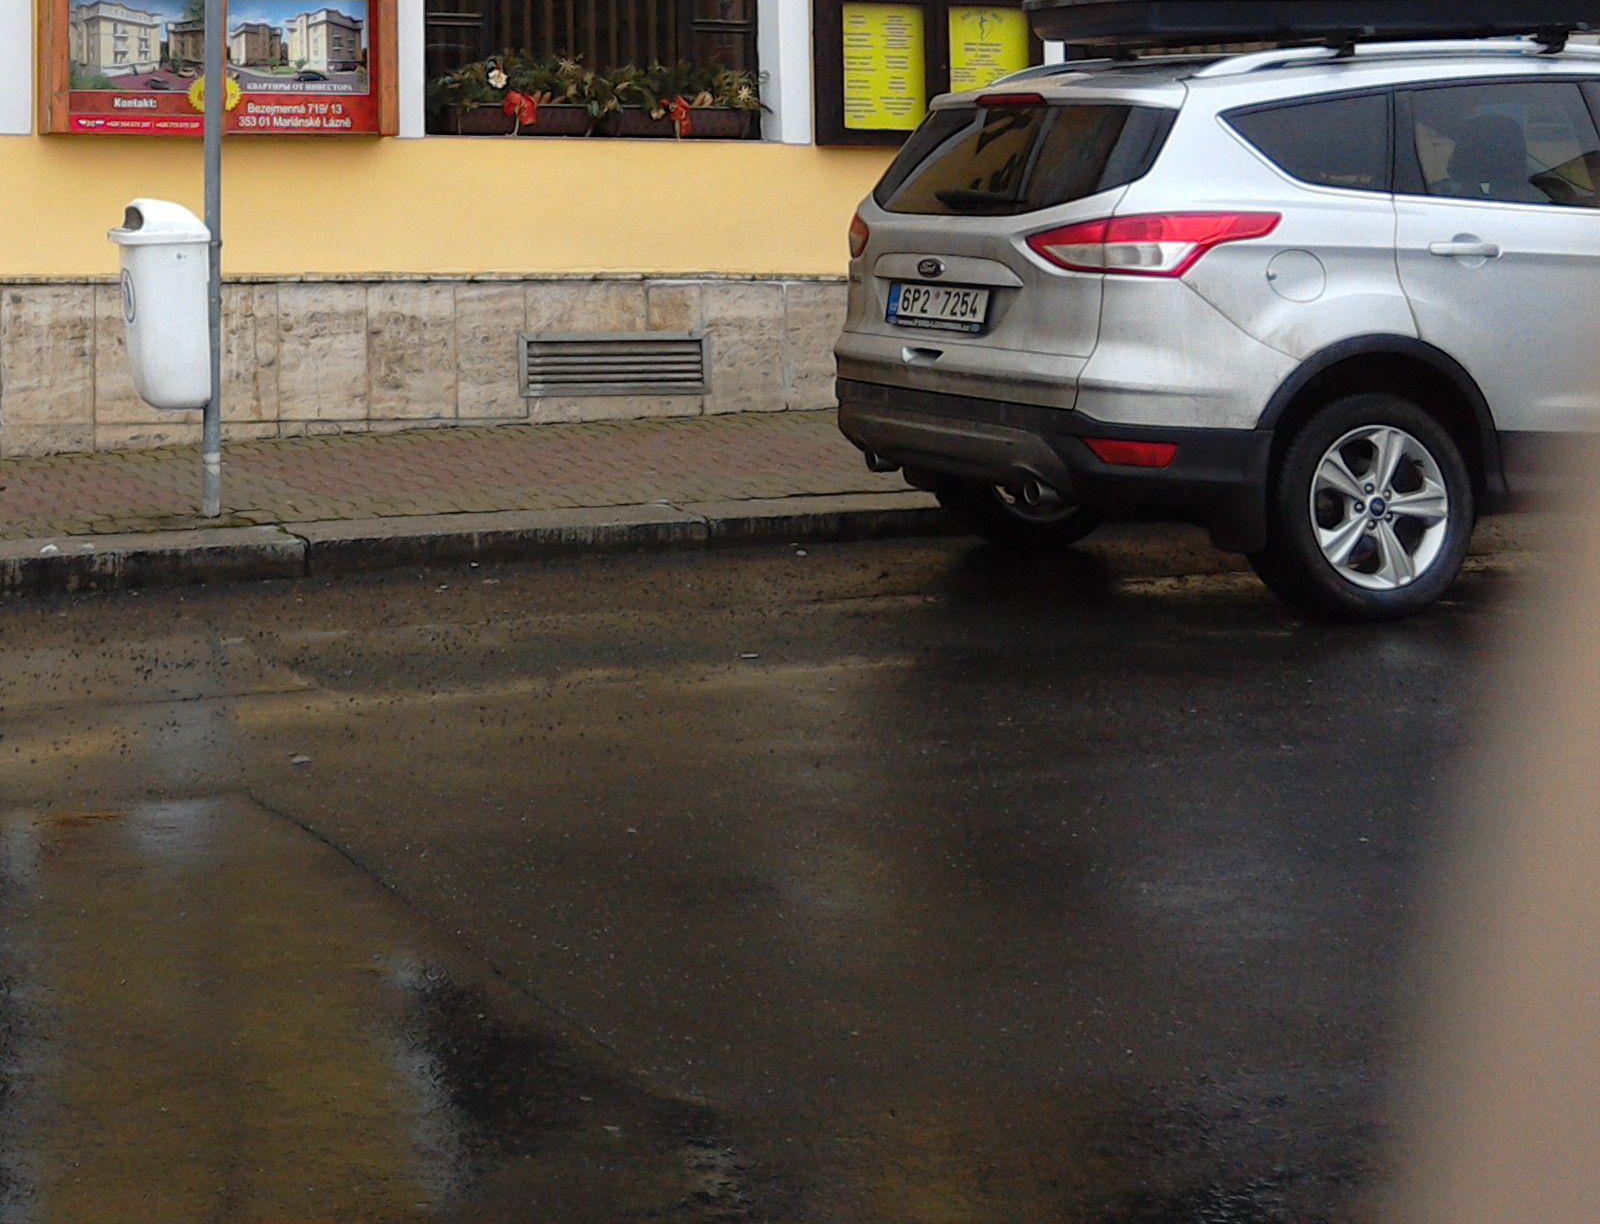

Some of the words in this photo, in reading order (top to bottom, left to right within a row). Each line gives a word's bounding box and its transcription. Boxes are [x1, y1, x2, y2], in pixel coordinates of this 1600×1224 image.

[113, 97, 158, 109] Kontakt:
[901, 287, 931, 314] 6P2
[940, 290, 979, 318] 7254
